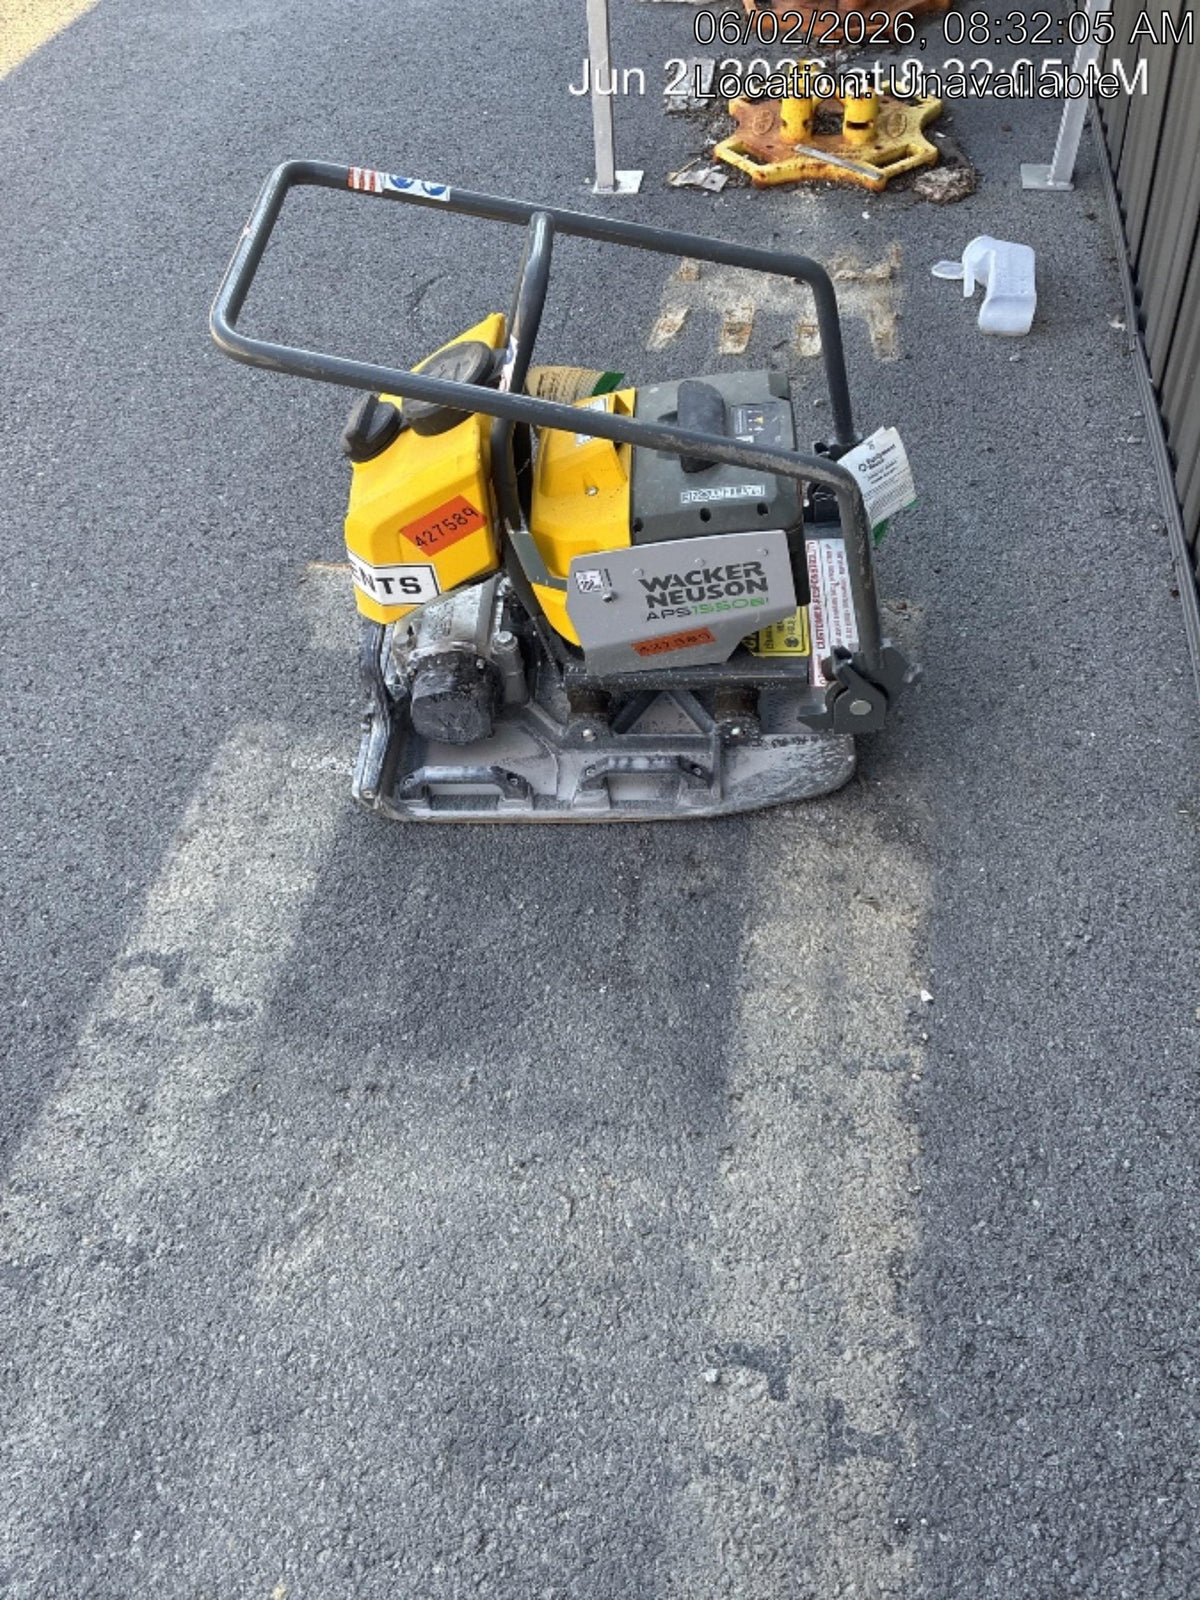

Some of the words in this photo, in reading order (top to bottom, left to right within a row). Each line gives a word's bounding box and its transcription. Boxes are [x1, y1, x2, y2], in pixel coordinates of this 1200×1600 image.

[415, 506, 479, 548] 427589
[638, 561, 765, 593] WACKER
[645, 577, 769, 609] NEUSON
